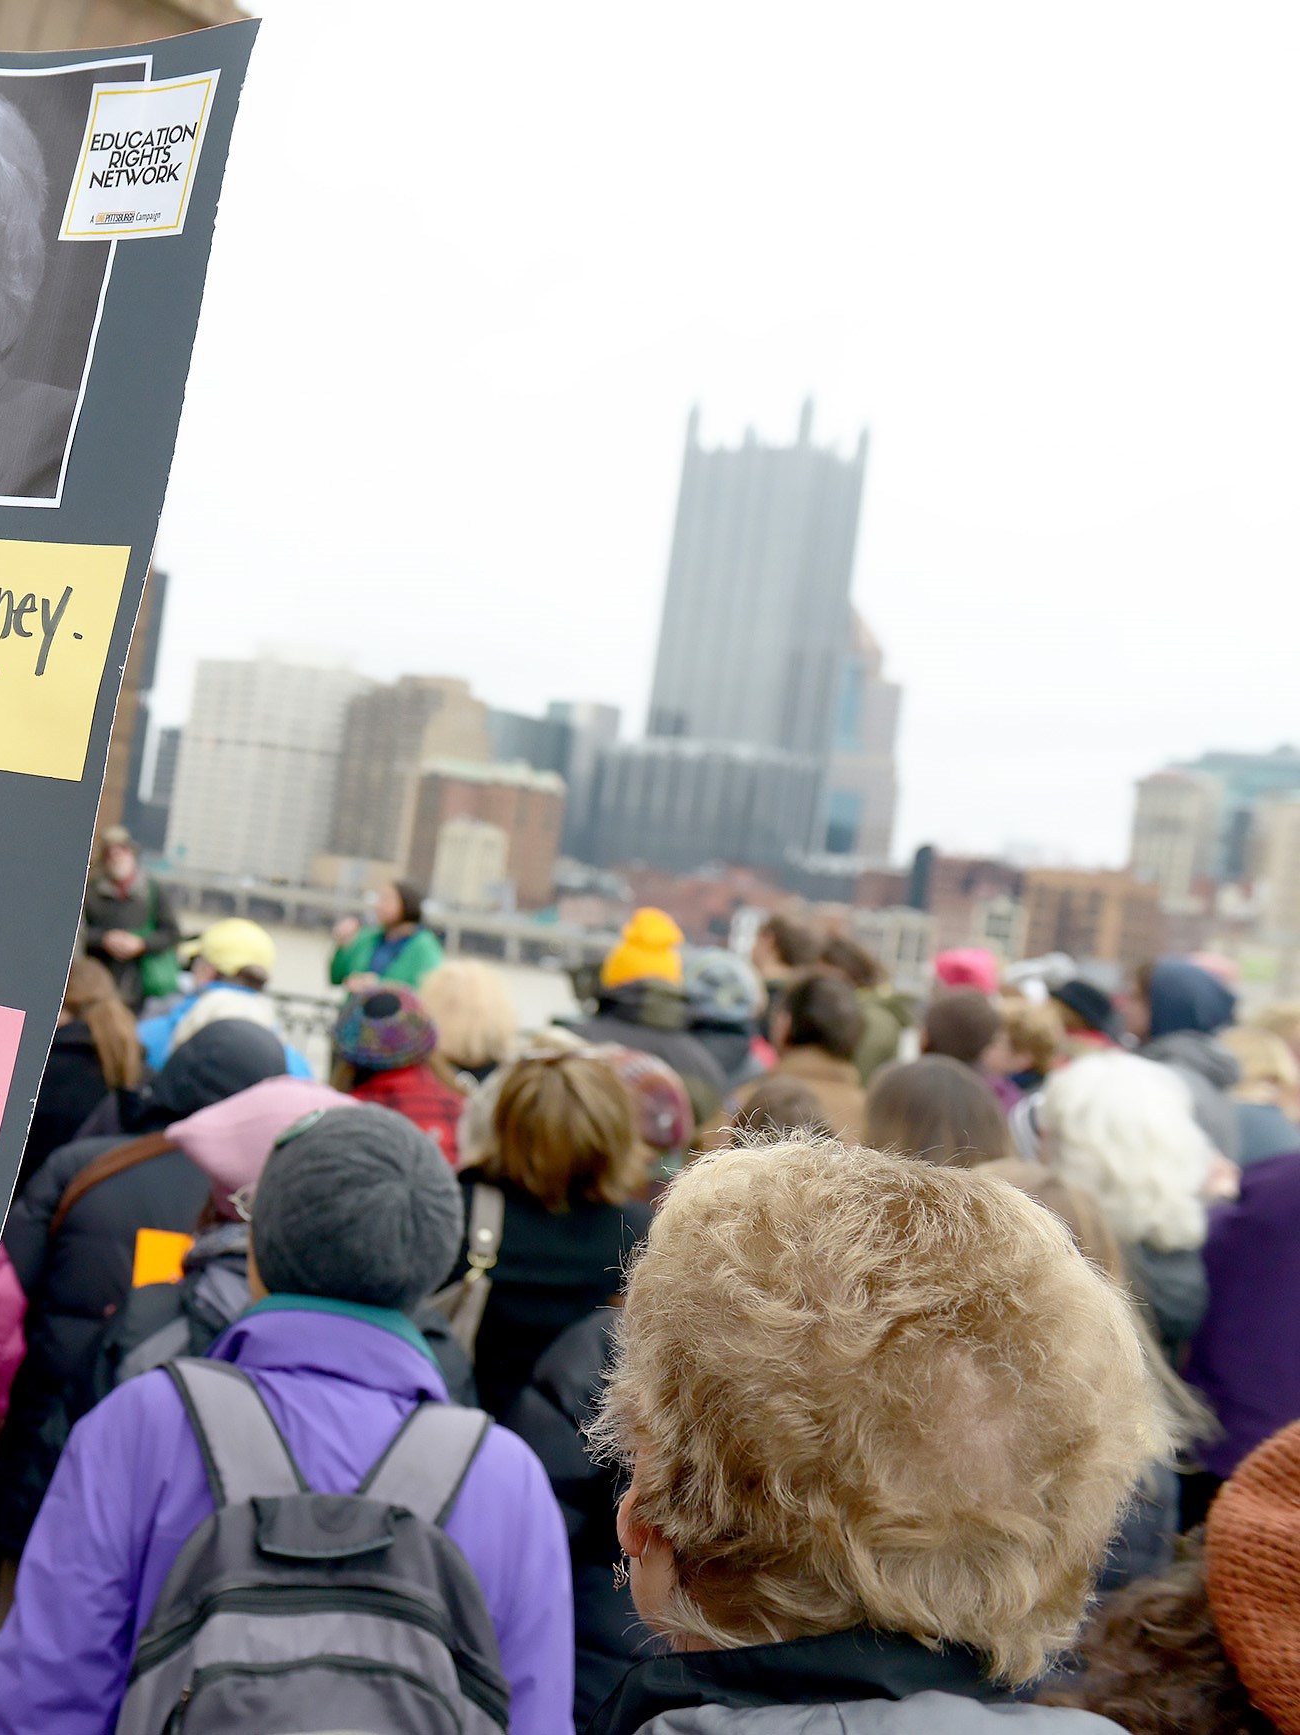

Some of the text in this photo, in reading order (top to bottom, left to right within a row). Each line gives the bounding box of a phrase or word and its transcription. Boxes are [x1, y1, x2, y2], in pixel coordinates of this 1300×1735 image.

[90, 122, 198, 151] EDUCATION
[108, 145, 172, 168] RIGHTS
[89, 162, 182, 189] NETWORK
